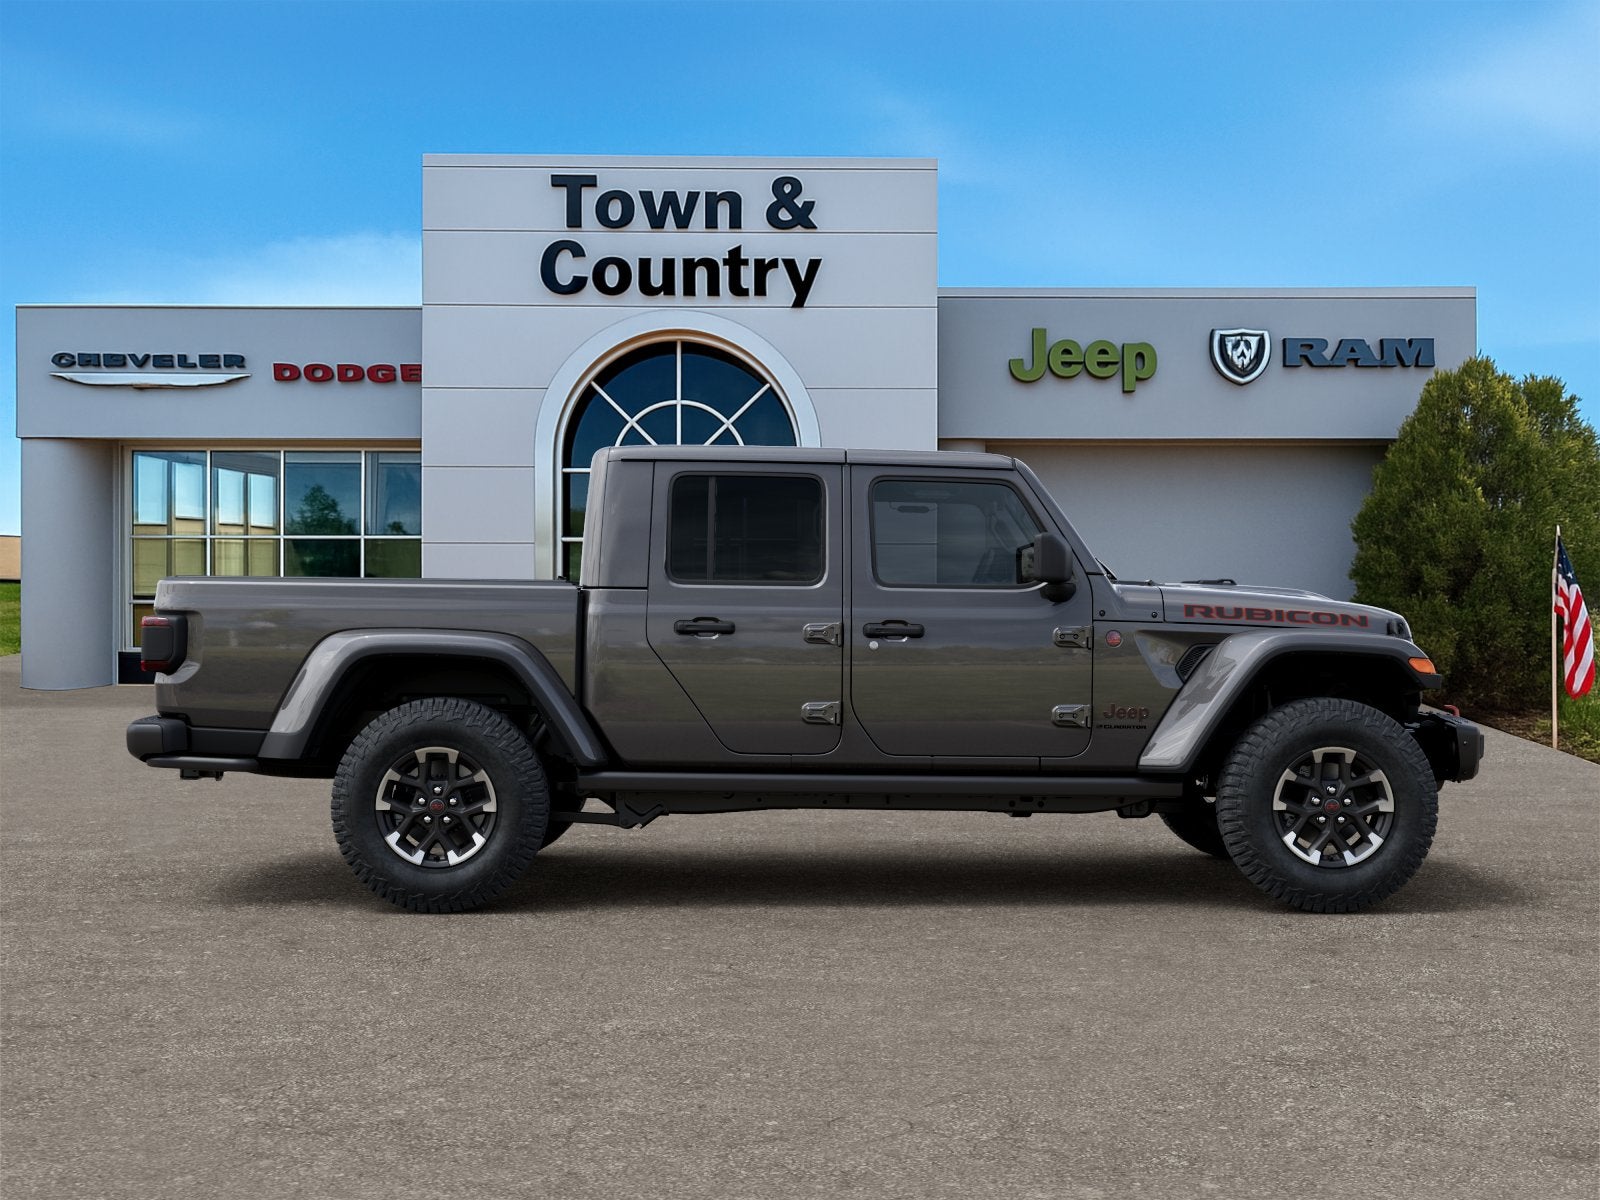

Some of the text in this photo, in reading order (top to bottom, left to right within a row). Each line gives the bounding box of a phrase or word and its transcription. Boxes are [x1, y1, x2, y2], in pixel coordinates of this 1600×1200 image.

[551, 174, 818, 230] Town &
[540, 239, 822, 308] Country
[1009, 328, 1157, 393] Jeep
[1282, 337, 1435, 368] RAM
[273, 363, 422, 383] DODGE
[1183, 604, 1369, 628] RUBICON
[1103, 703, 1150, 722] Jeep
